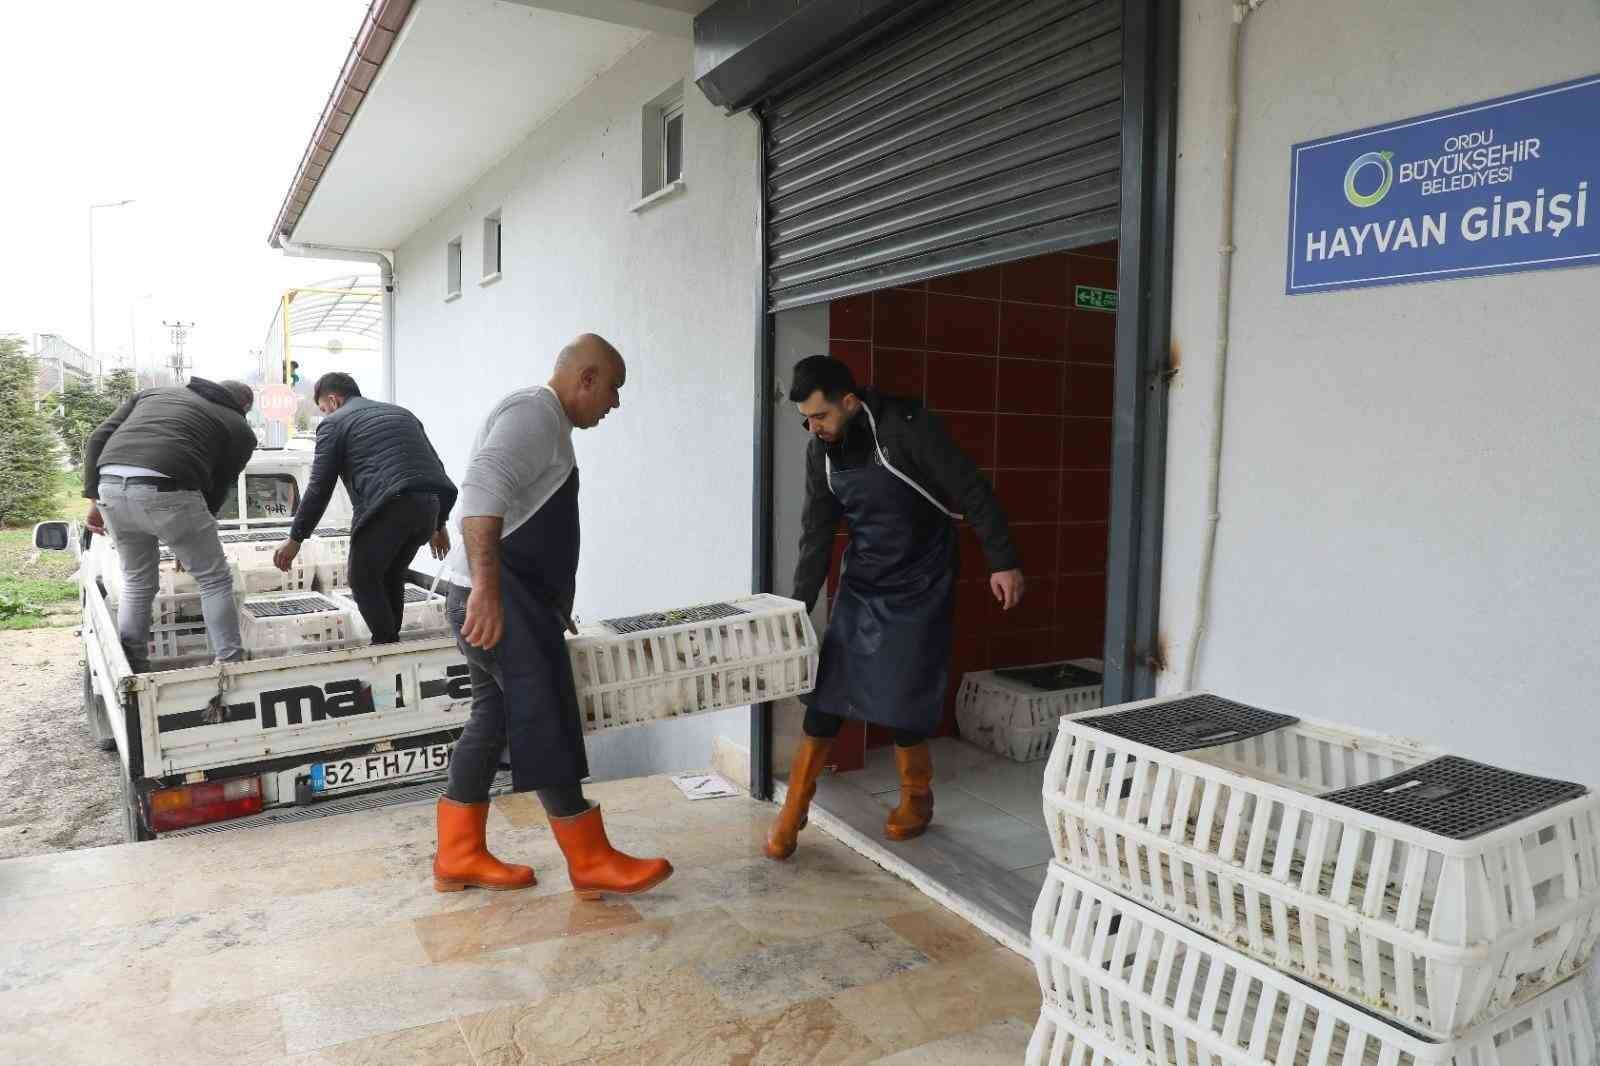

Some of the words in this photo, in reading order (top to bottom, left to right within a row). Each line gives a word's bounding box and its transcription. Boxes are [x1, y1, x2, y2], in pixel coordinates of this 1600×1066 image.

[1444, 129, 1494, 153] ORDU
[1399, 138, 1541, 184] BÜYÜKŞEHİR
[1421, 166, 1513, 196] BELEDİYESİ
[1306, 212, 1447, 262] HAYVAN
[1461, 181, 1588, 242] GİRİŞİ
[325, 761, 354, 785] 52
